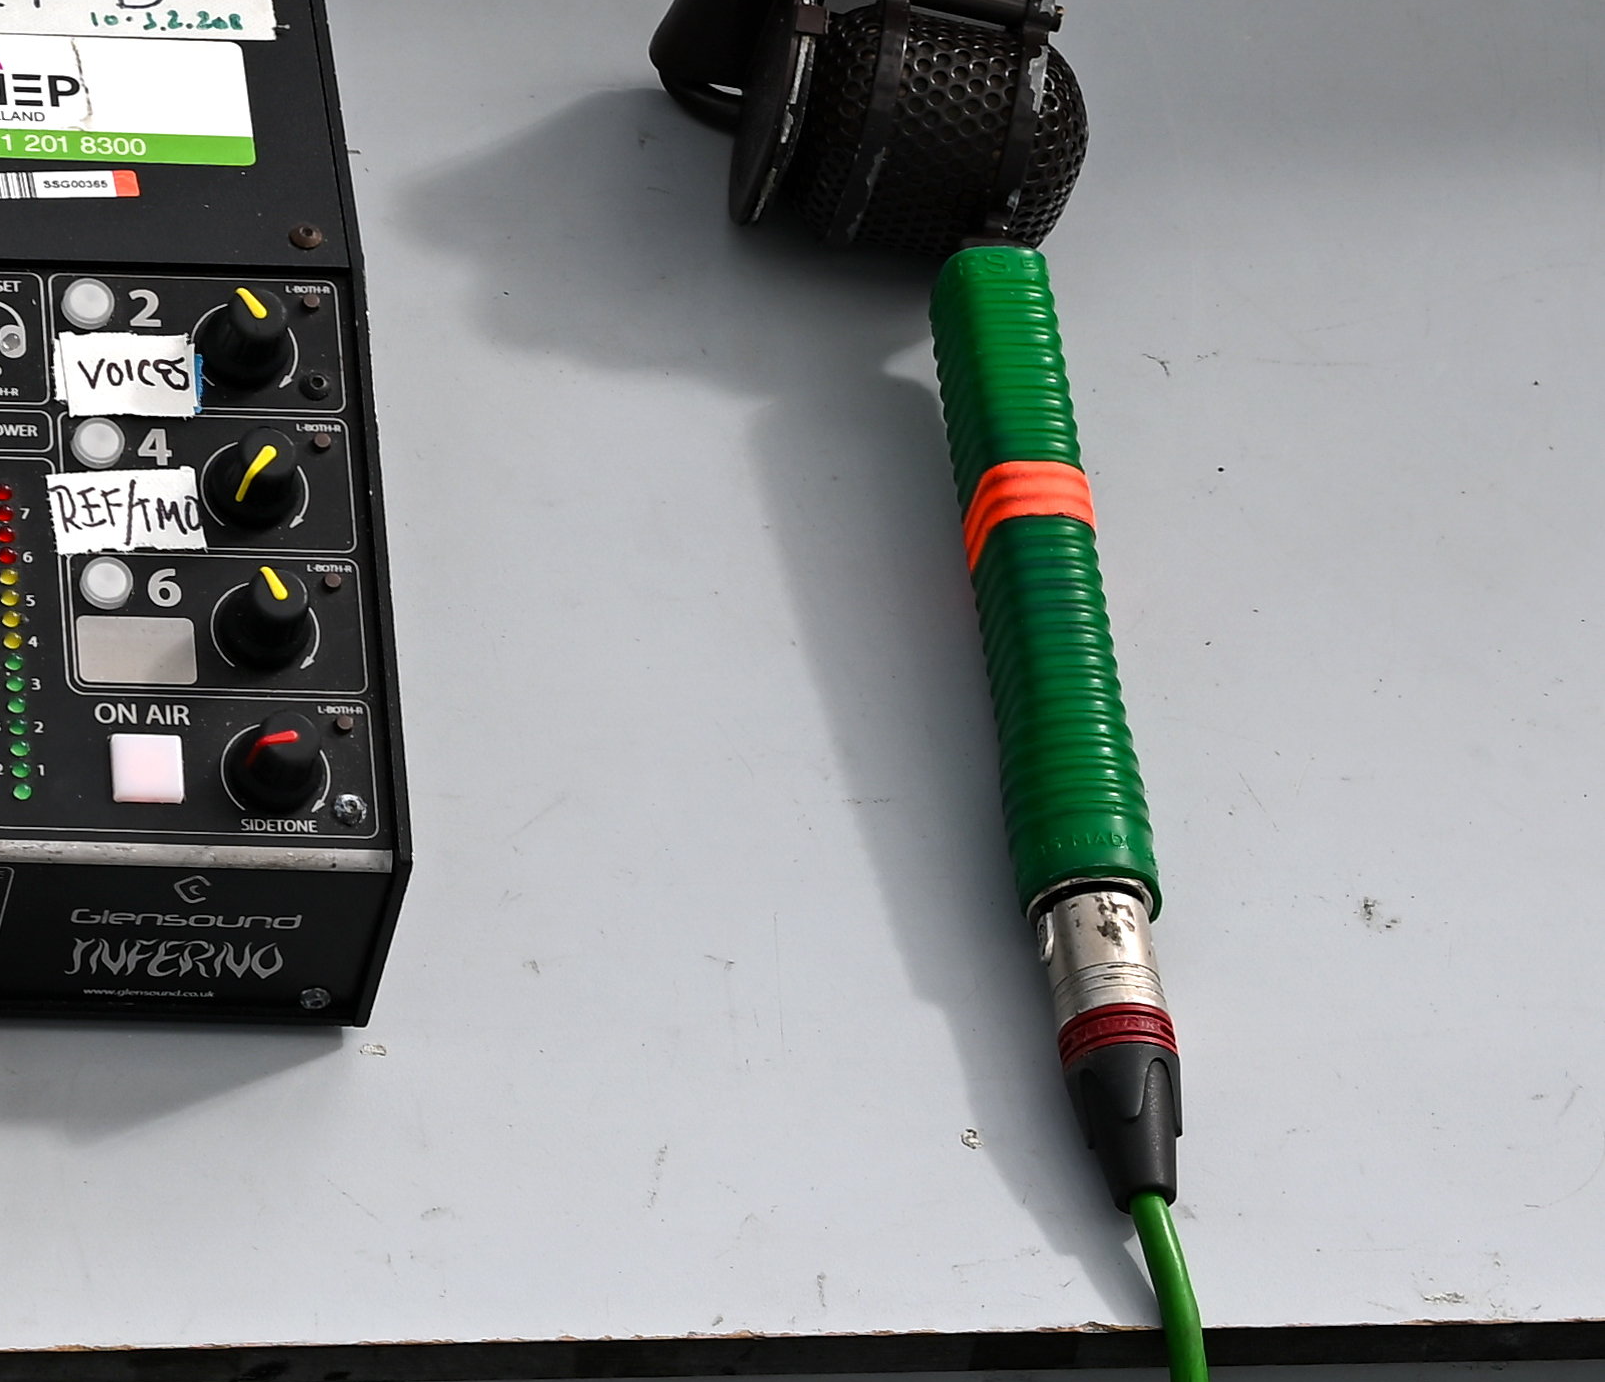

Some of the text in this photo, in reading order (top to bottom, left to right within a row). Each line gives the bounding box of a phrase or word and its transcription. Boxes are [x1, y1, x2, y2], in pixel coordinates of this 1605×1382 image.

[1, 134, 11, 150] 1
[25, 135, 67, 152] 201
[80, 137, 146, 155] 8300
[43, 180, 107, 188] SSG00365
[129, 290, 161, 327] 2
[78, 357, 190, 391] VOICES
[296, 424, 341, 432] L-BOTH-R
[138, 429, 172, 465] 4
[20, 508, 29, 519] 7
[23, 552, 33, 562] 6
[307, 564, 352, 572] L-BOTH-R
[148, 569, 181, 607] 6
[26, 595, 35, 606] 5
[28, 636, 37, 647] 4
[32, 678, 41, 690] 3
[95, 703, 190, 725] ON AIR
[318, 706, 363, 714] L-BOTH-R
[34, 722, 43, 733] 2
[38, 765, 44, 776] 1
[241, 819, 318, 833] SIDETONE
[70, 908, 302, 929] Glensound
[64, 937, 283, 979] INFERNO
[83, 987, 214, 999] www.glensound.co.uk
